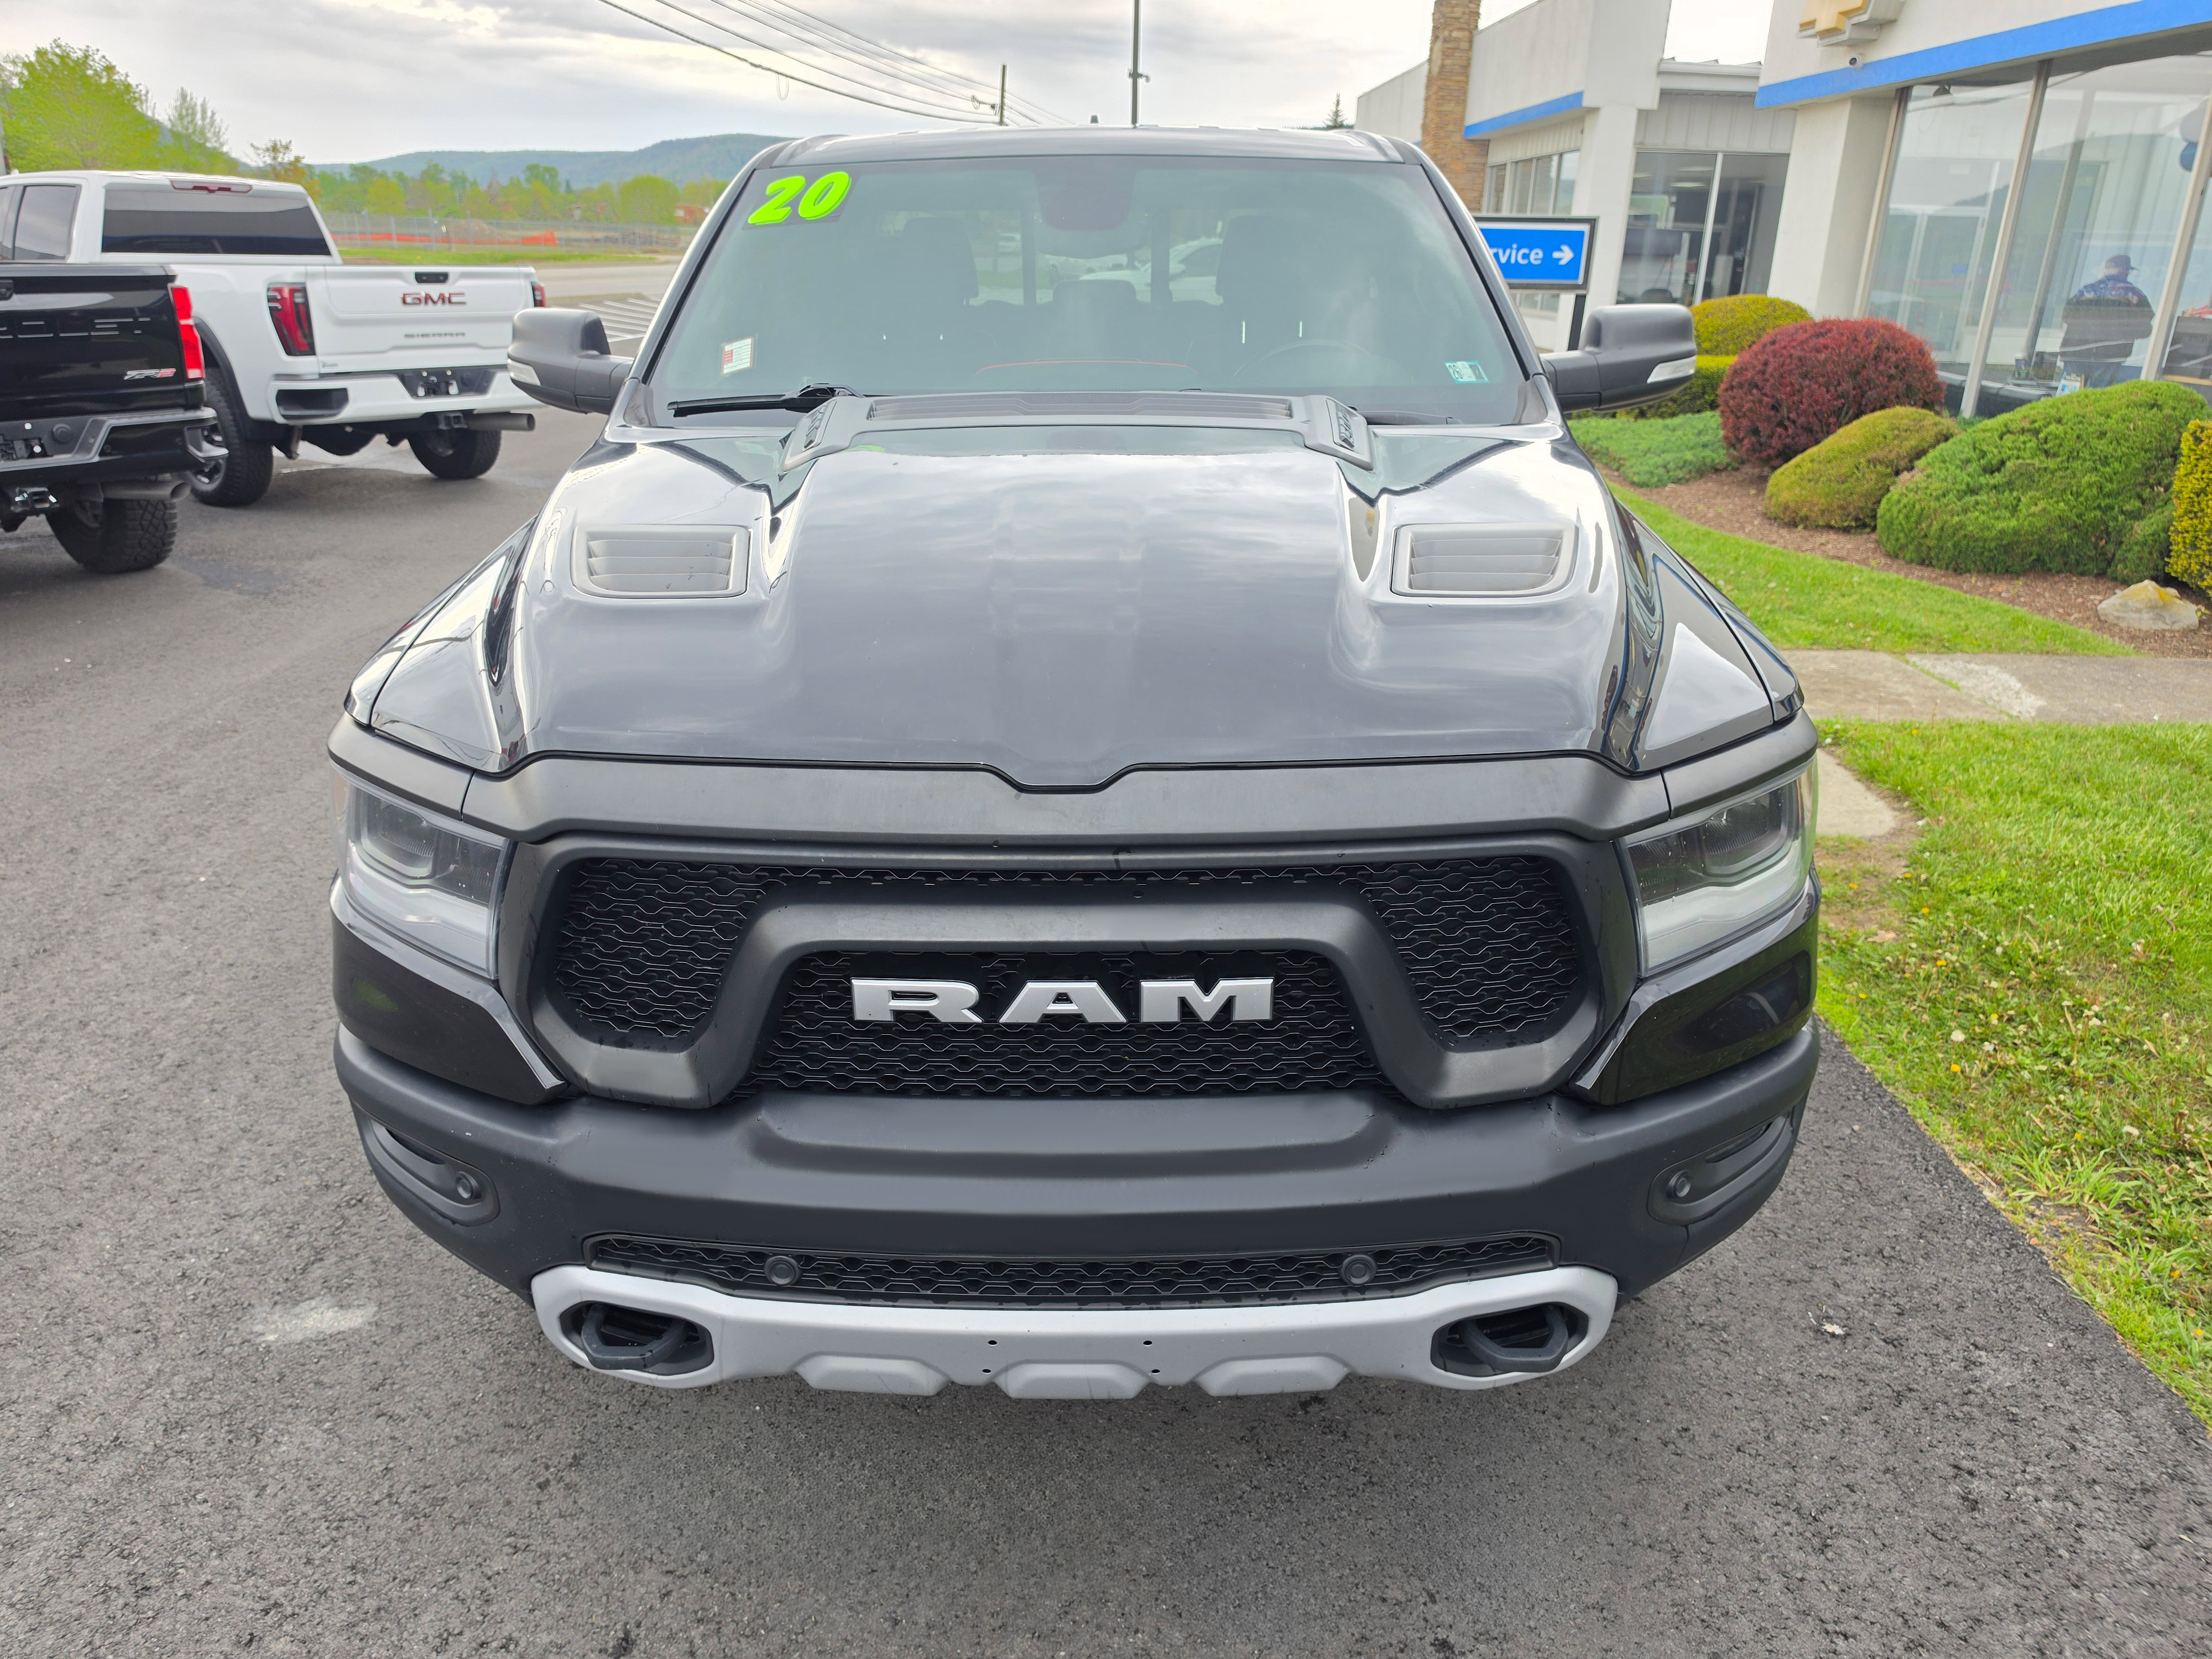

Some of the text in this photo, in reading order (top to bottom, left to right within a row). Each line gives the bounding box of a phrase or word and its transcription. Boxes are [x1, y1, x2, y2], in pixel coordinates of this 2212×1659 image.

[748, 171, 852, 226] 20
[1490, 243, 1543, 264] rvice
[401, 292, 467, 305] GMC
[851, 977, 1275, 1024] RAM
